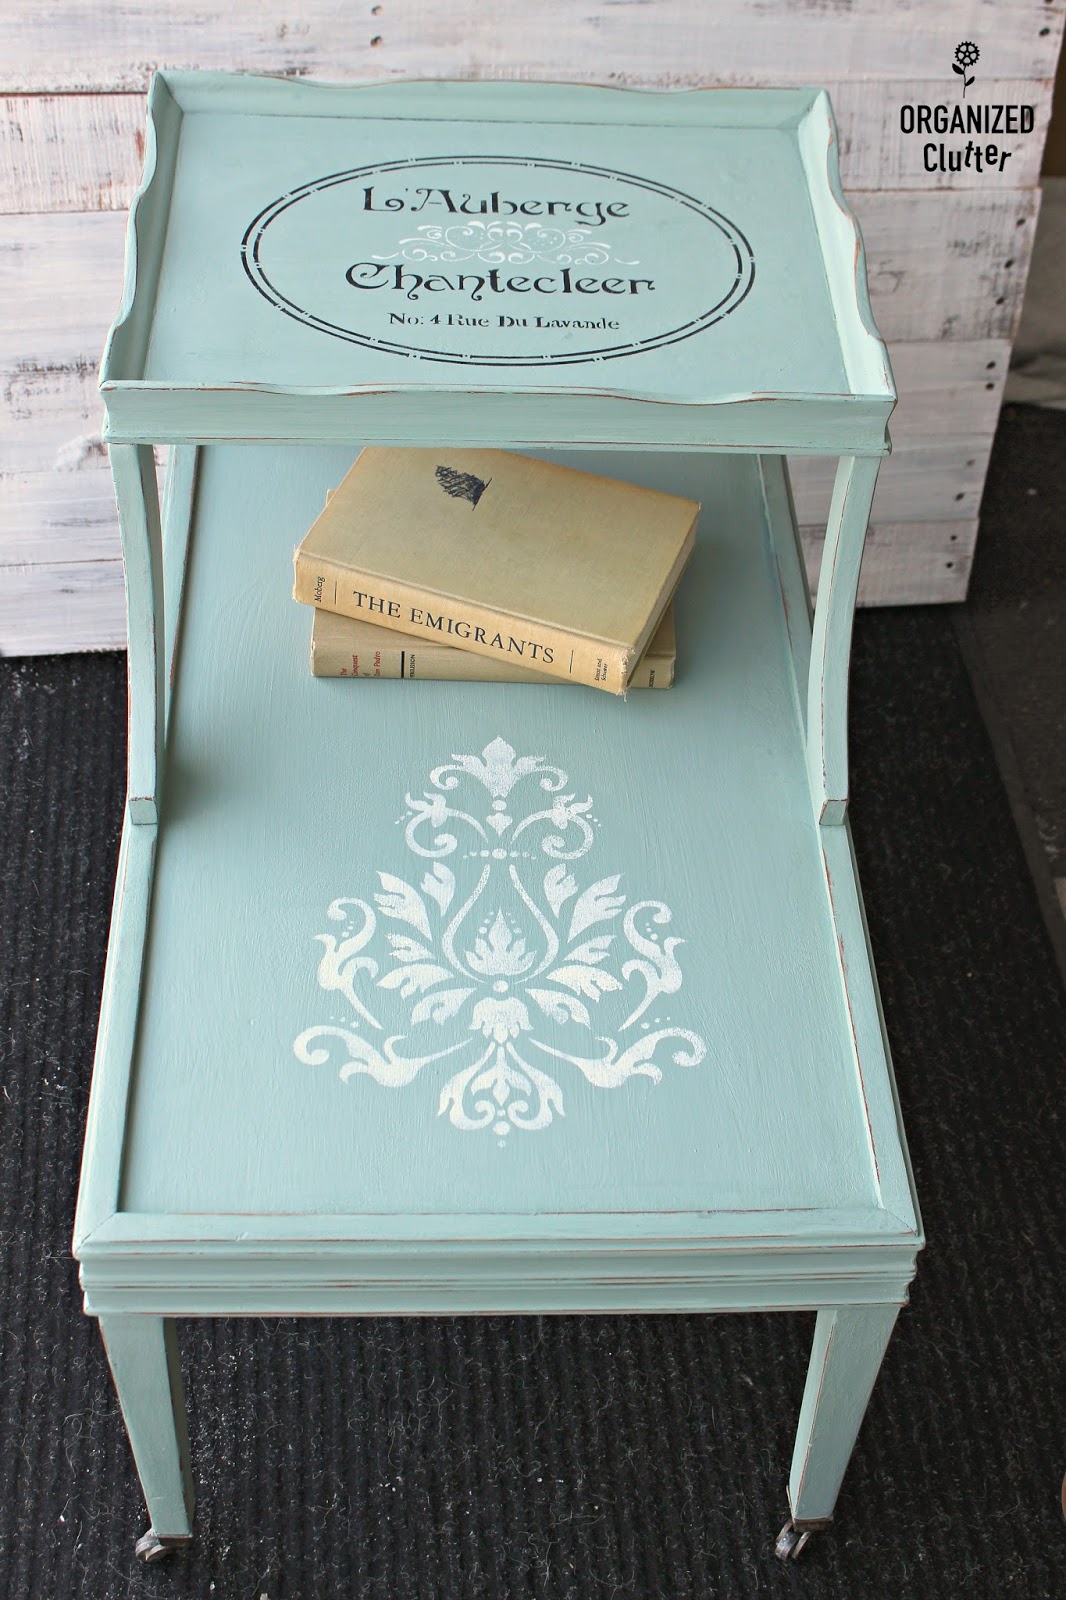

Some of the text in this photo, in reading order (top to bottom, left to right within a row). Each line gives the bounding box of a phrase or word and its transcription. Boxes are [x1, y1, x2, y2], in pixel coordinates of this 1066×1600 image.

[363, 186, 630, 227] L'Auberge
[345, 262, 655, 301] Chantecleer
[430, 314, 441, 326] 4
[447, 313, 490, 328] Rue
[497, 315, 528, 328] Du
[534, 316, 620, 330] Lavande
[314, 576, 326, 603] Moberg
[353, 590, 555, 664] THE EMIGRANTS
